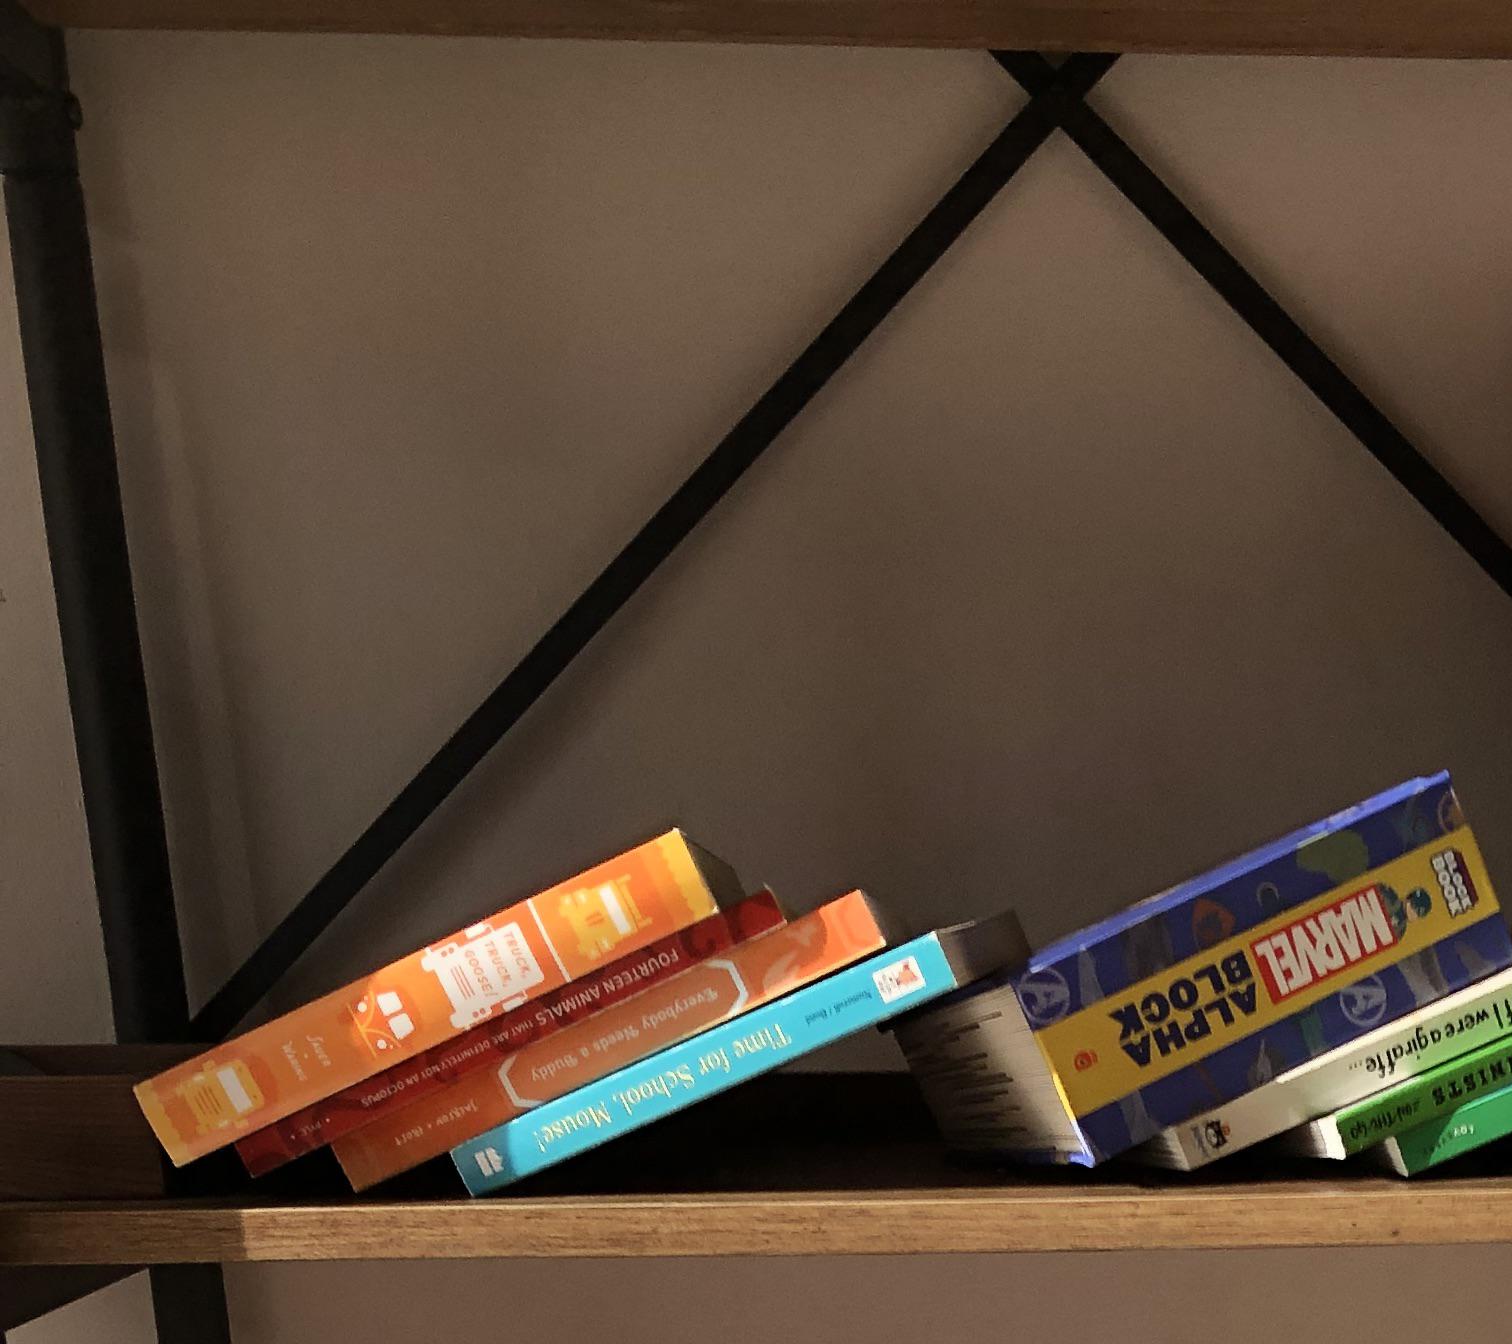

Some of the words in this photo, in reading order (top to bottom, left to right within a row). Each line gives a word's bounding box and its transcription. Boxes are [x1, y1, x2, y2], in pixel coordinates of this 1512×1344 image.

[484, 941, 512, 988] TRUCK,
[503, 930, 528, 978] TRUCK,
[1252, 886, 1396, 999] MARVEL
[464, 950, 499, 998] GOOSE!
[1107, 948, 1254, 1042] BLOCK
[639, 982, 720, 1034] Everybody
[1120, 982, 1265, 1073] ALPHA
[589, 1021, 641, 1057] Needs
[695, 1045, 733, 1081] for
[727, 1019, 793, 1068] Time
[526, 1048, 579, 1086] Buddy
[610, 1061, 697, 1119] School,
[530, 1098, 613, 1154] Mouse!
